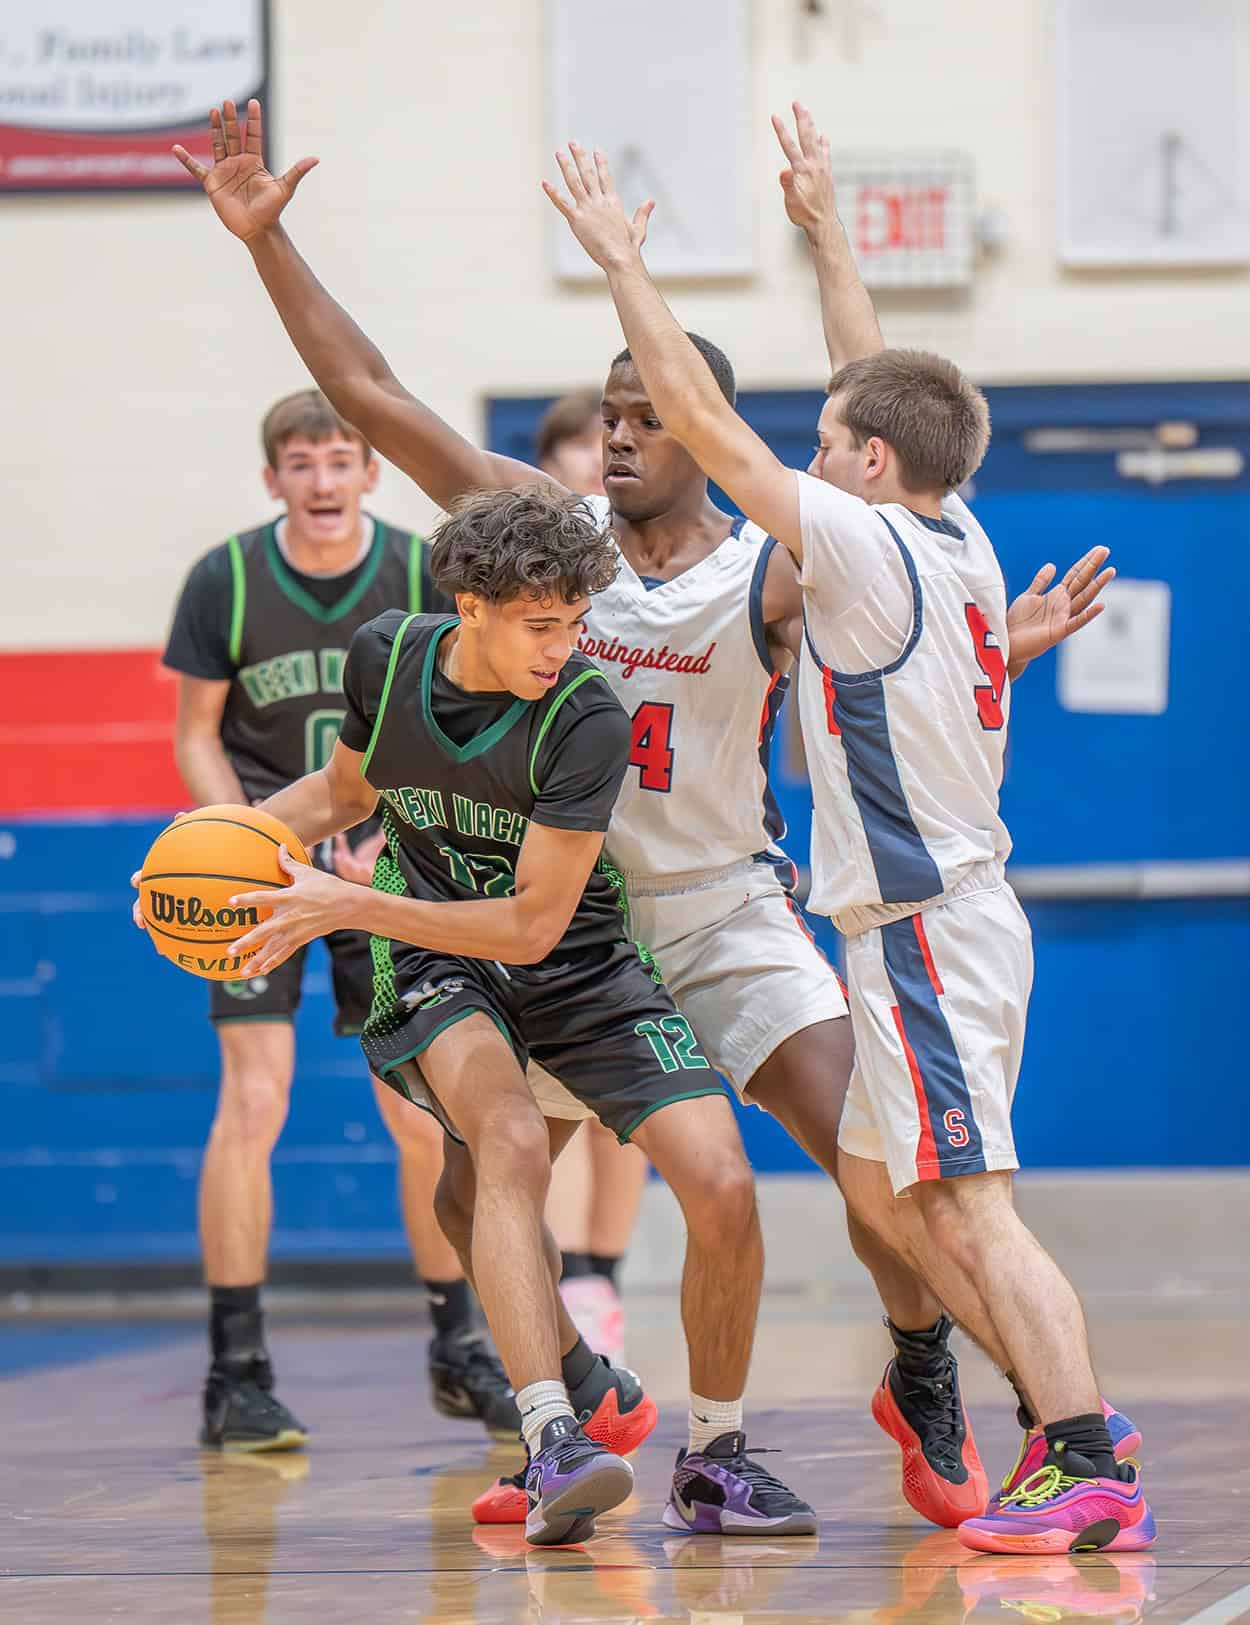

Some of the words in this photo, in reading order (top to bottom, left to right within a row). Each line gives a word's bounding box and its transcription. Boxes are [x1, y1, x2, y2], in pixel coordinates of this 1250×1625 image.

[38, 27, 160, 70] Family
[173, 26, 247, 64] Law
[857, 184, 946, 256] EXIT
[628, 701, 675, 793] 4
[150, 889, 259, 928] Wilson
[634, 1014, 710, 1073] 12
[944, 1108, 969, 1147] S
